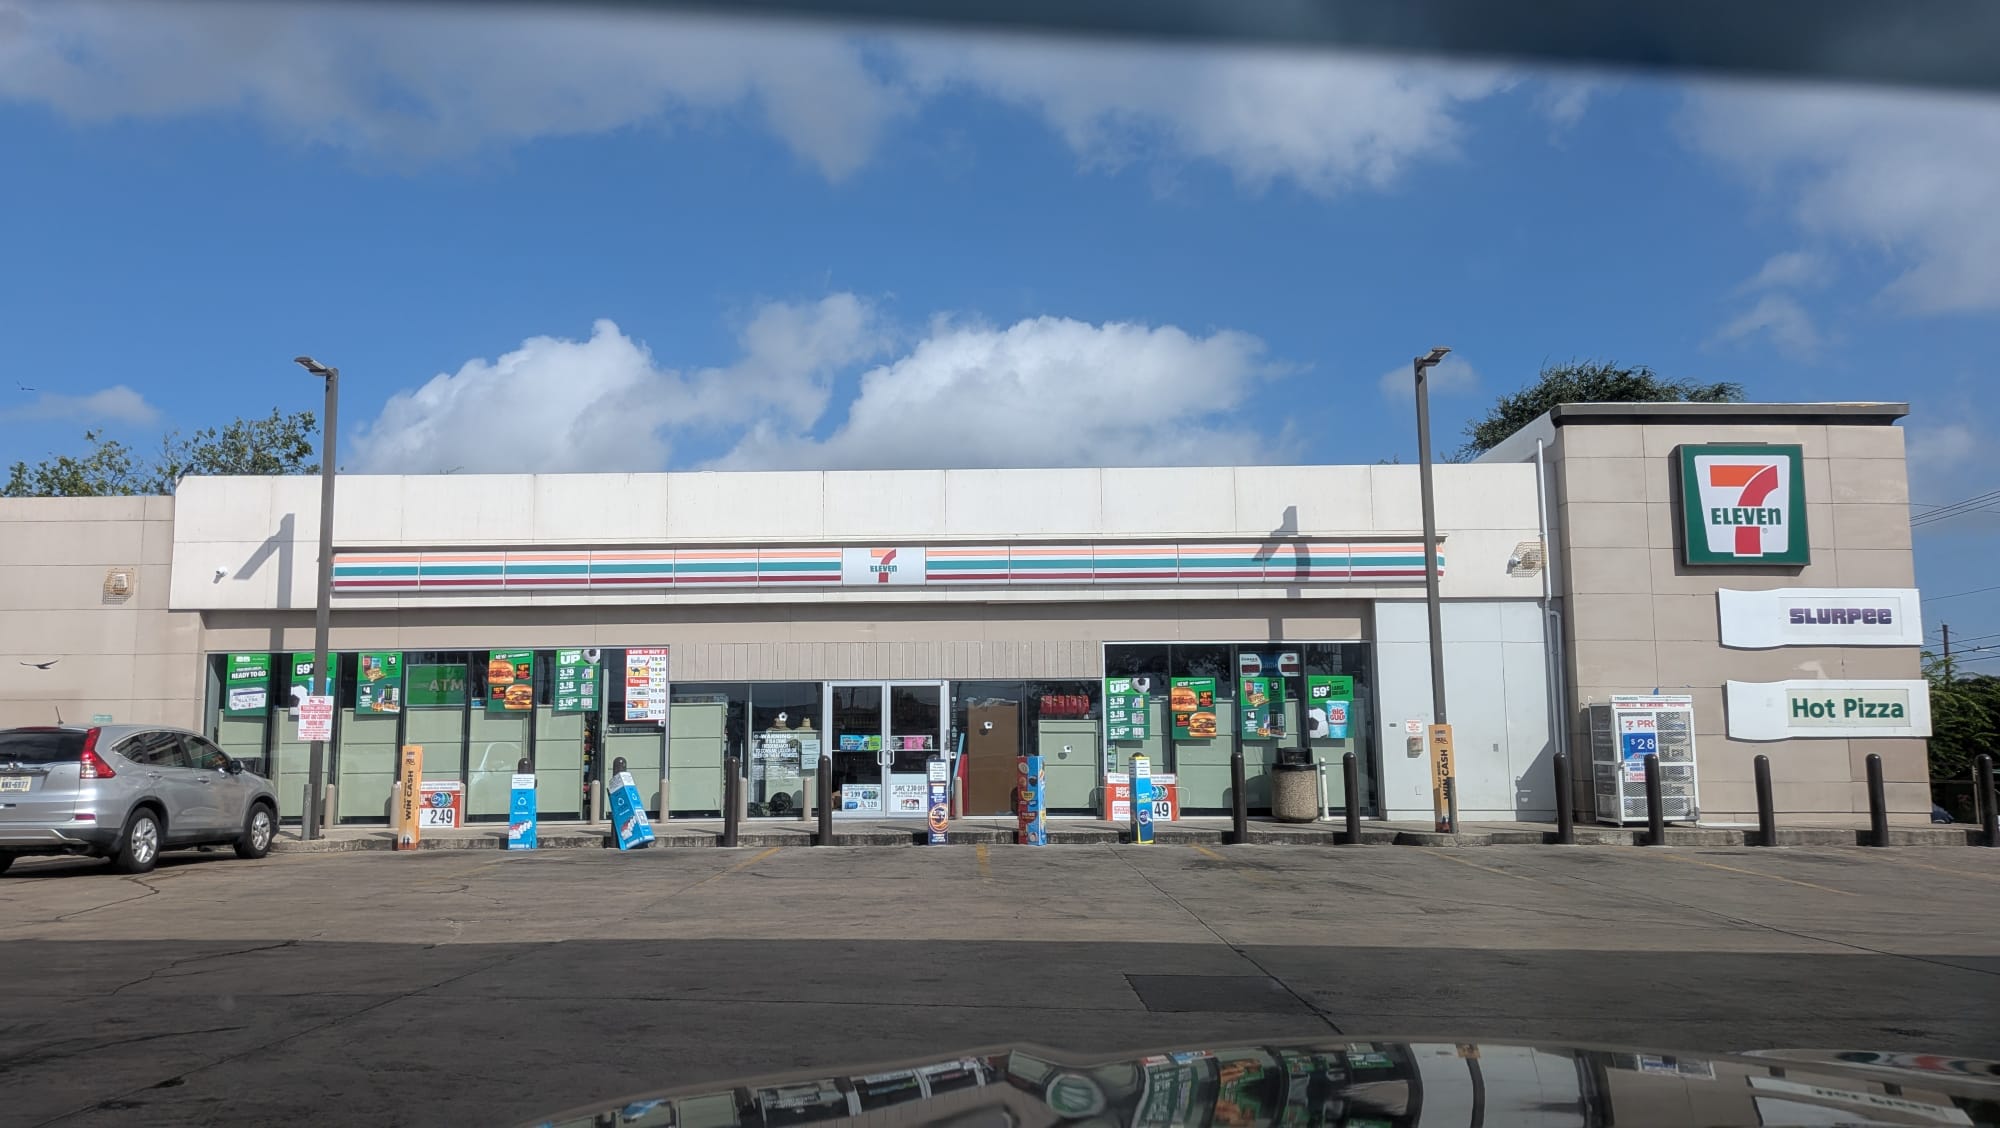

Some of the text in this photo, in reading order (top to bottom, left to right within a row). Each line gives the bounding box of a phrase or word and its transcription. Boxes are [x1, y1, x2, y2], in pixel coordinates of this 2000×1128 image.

[1709, 464, 1779, 555] 7
[871, 548, 897, 583] 7
[560, 655, 581, 665] UP
[231, 672, 250, 680] READY
[429, 679, 464, 692] ATM
[1110, 684, 1130, 694] UP
[1331, 708, 1345, 716] BIG
[1792, 697, 1905, 719] Hot Pizza
[1440, 749, 1449, 776] CASH
[406, 770, 414, 796] CASH
